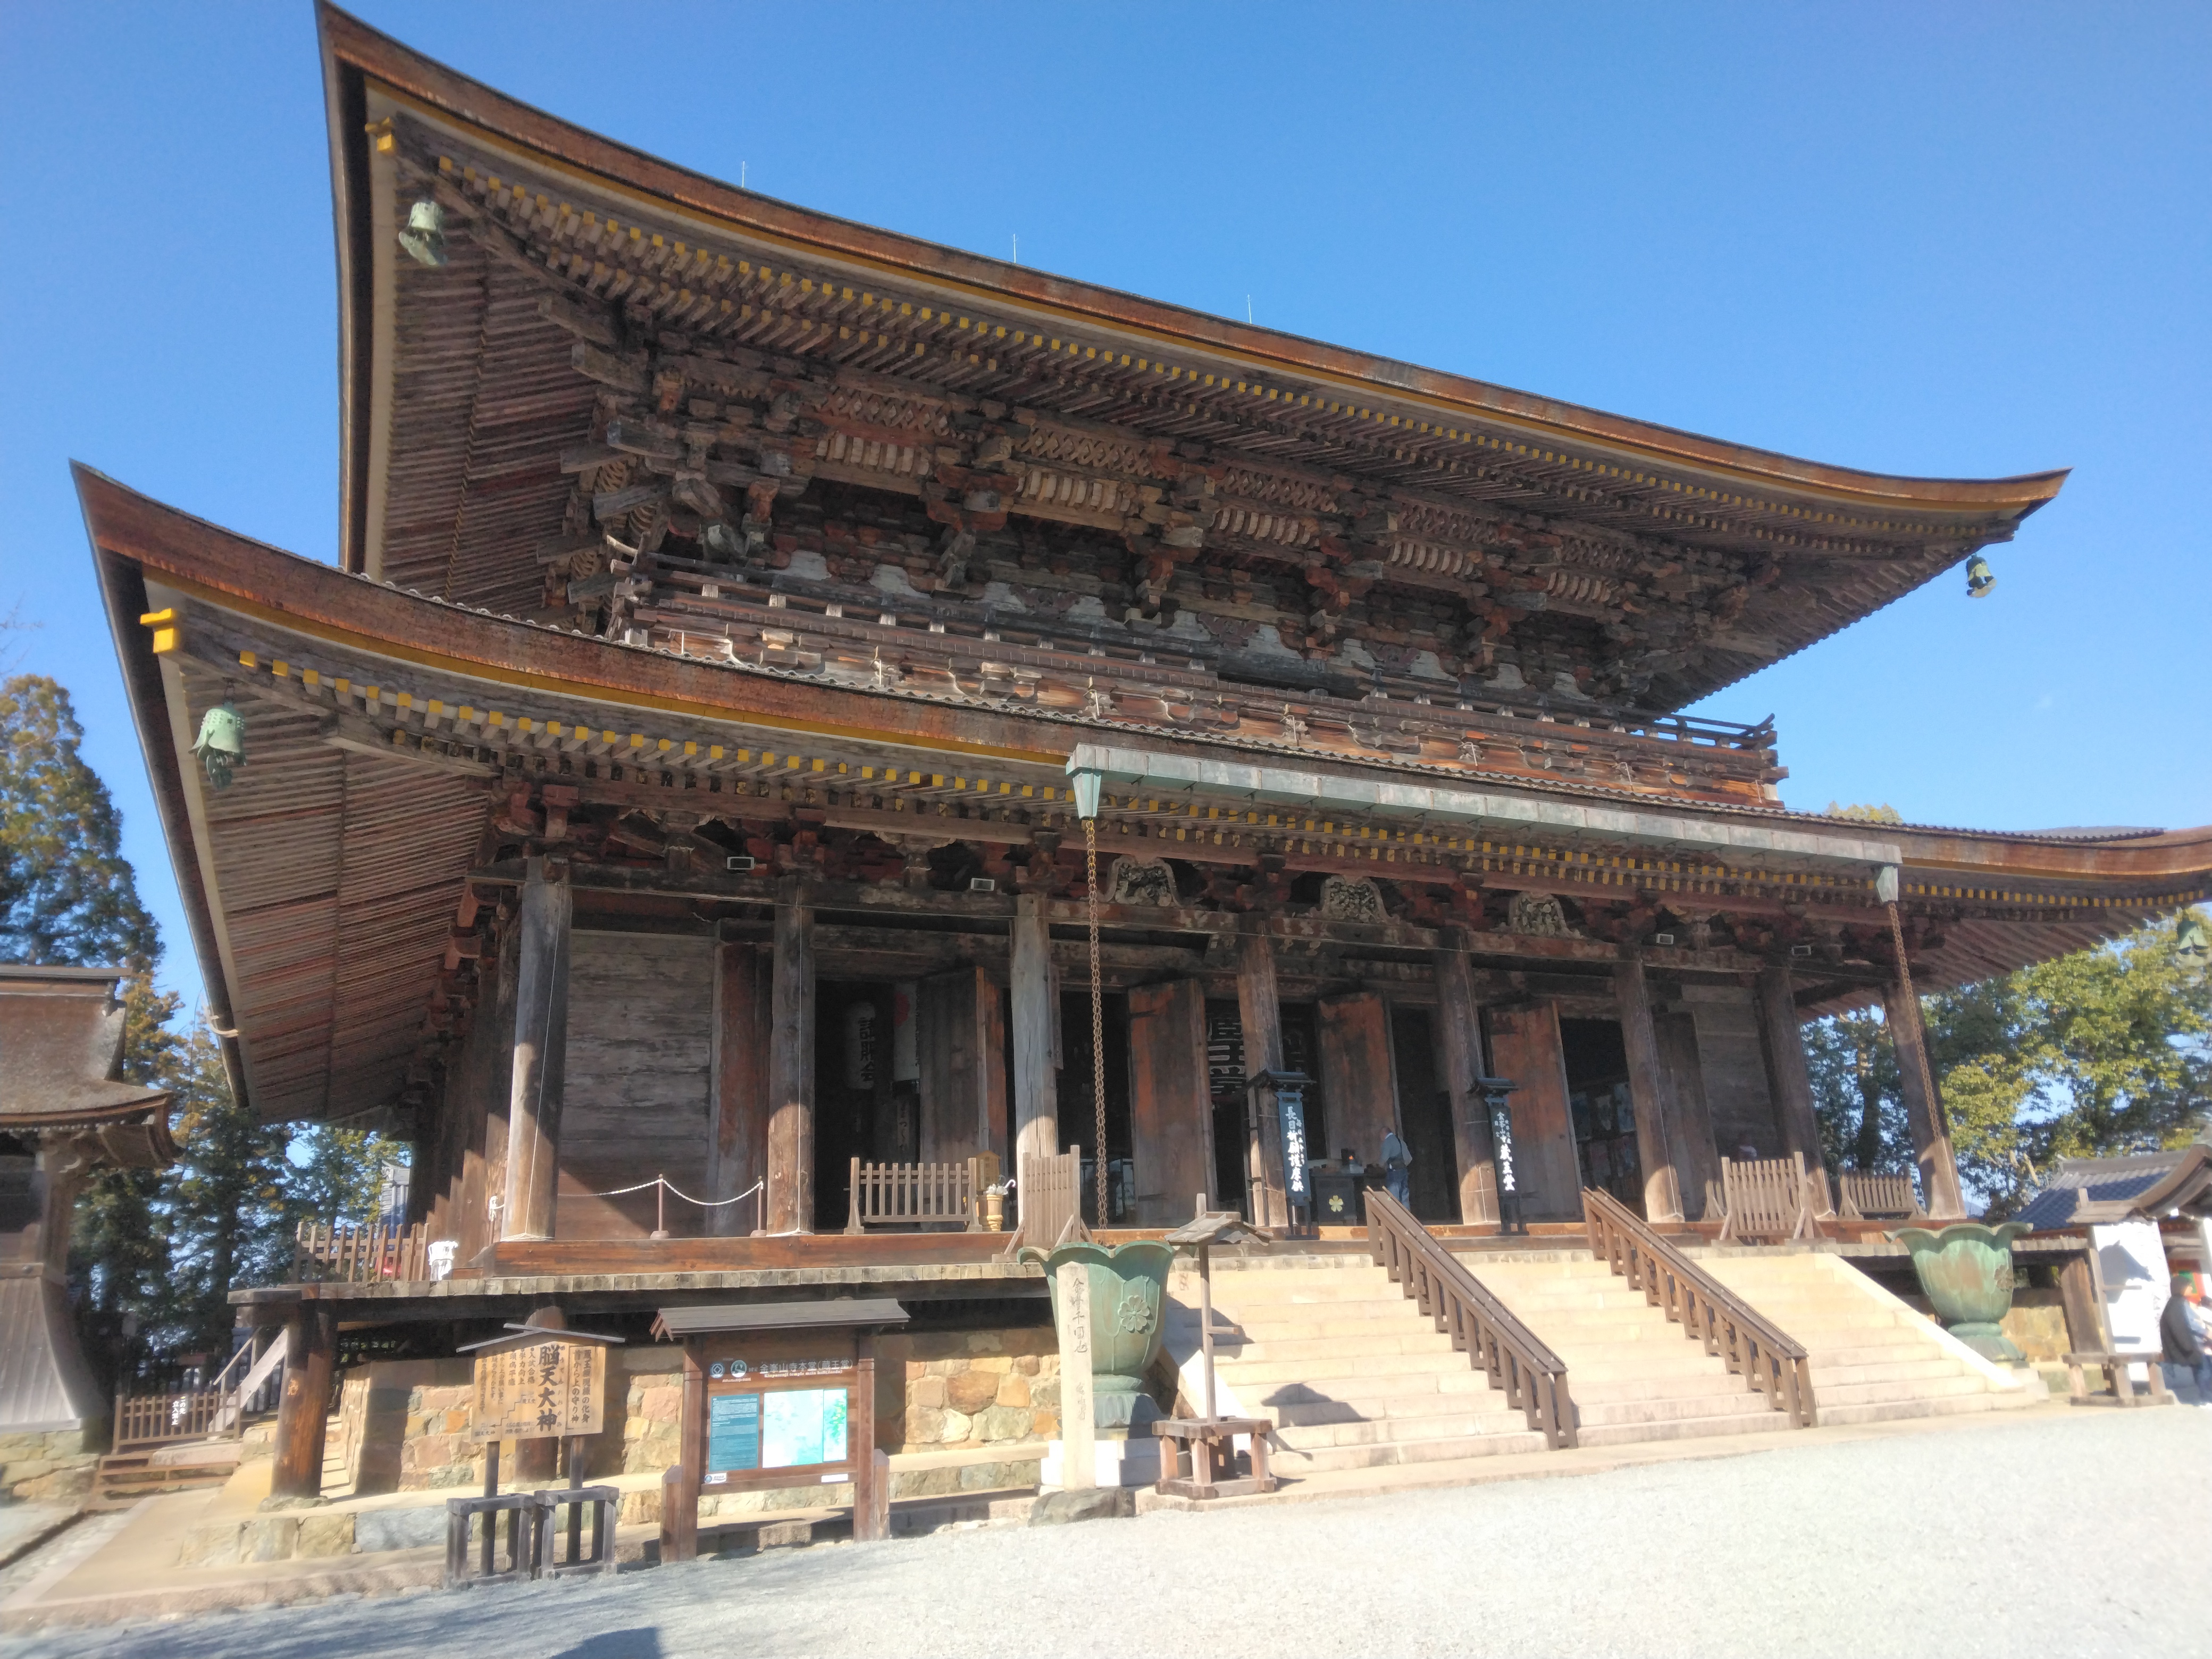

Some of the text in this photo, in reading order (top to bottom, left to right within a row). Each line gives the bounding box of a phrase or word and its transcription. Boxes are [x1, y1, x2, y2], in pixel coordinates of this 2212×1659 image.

[517, 1352, 526, 1385] 学力向上
[526, 1352, 536, 1384] 入試合格
[535, 1345, 561, 1431] 脳天大神
[571, 1349, 581, 1423] 首から上の守り神
